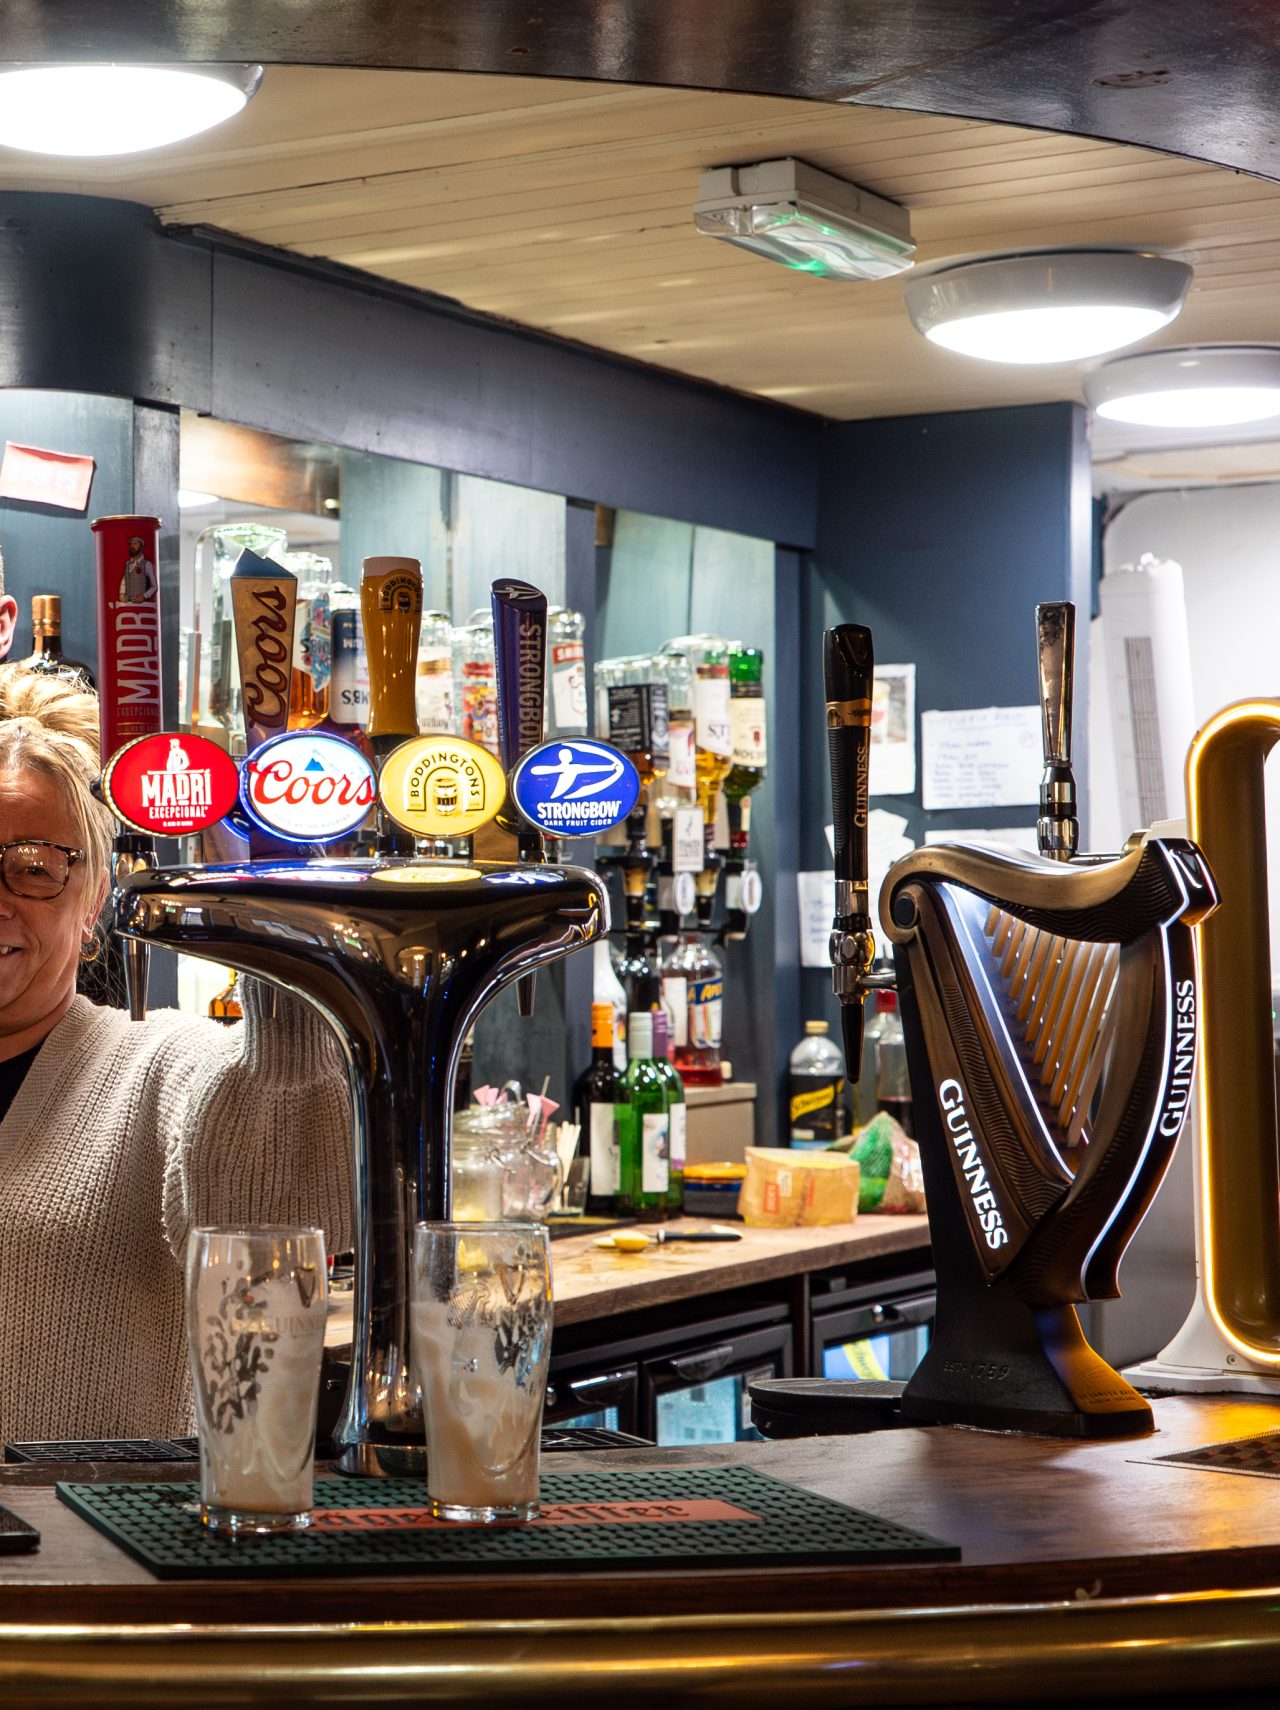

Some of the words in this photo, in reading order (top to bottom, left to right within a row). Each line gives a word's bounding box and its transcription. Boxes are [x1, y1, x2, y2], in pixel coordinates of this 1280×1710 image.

[245, 586, 288, 729] Coors
[116, 706, 160, 717] EXCEPCION
[341, 690, 370, 706] MB'S
[248, 759, 377, 806] Coors
[410, 752, 480, 798] BODDINGTONS
[853, 746, 868, 828] GUINNESS
[148, 806, 207, 820] EXCEPCIONAL
[536, 800, 621, 820] STRONGBOW
[543, 819, 565, 827] DARK
[565, 819, 589, 827] FRUIT
[590, 818, 613, 826] CIDER
[1159, 979, 1198, 1137] GUINNESS
[939, 1078, 1009, 1250] GUINNESS
